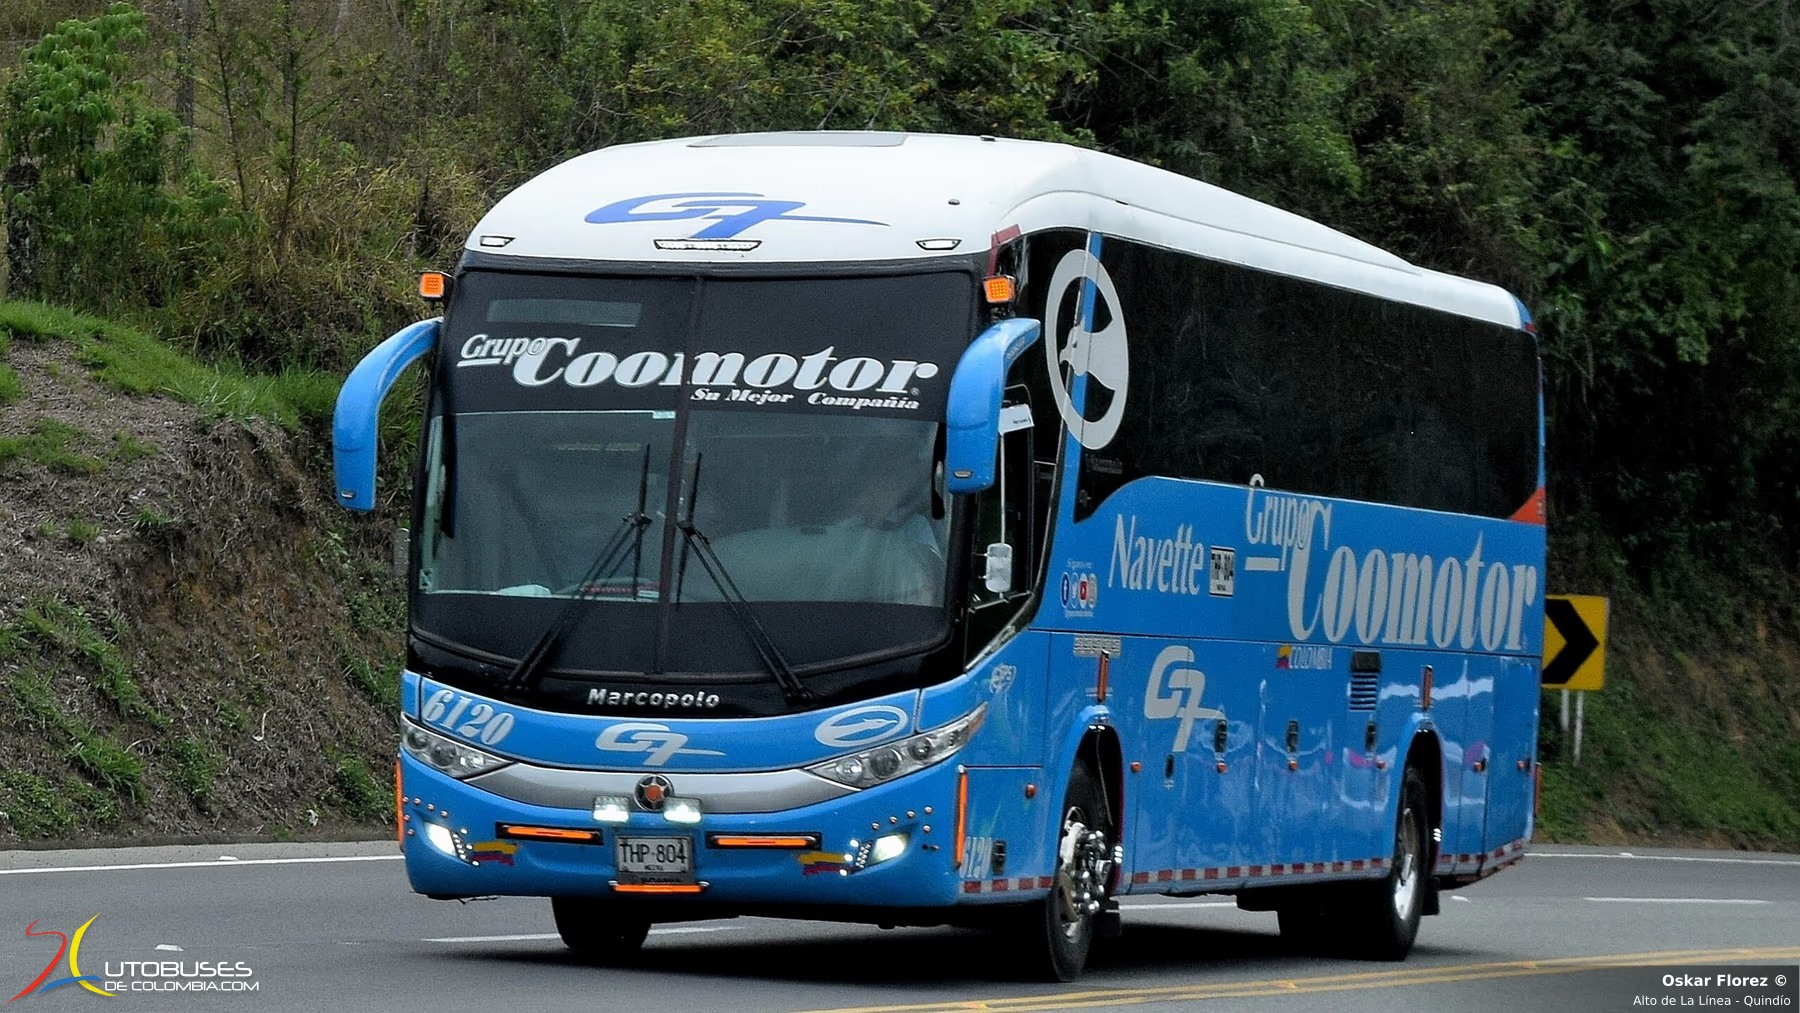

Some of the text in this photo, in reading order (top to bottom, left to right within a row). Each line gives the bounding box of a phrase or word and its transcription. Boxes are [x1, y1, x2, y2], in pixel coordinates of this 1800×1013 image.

[460, 333, 547, 370] Grupo
[690, 387, 920, 411] Su Mejor Compañía
[1245, 473, 1312, 570] Grupo
[1108, 514, 1204, 596] Navette
[587, 687, 721, 709] Marcopolo
[421, 688, 515, 747] 6120
[619, 842, 687, 864] THP-804
